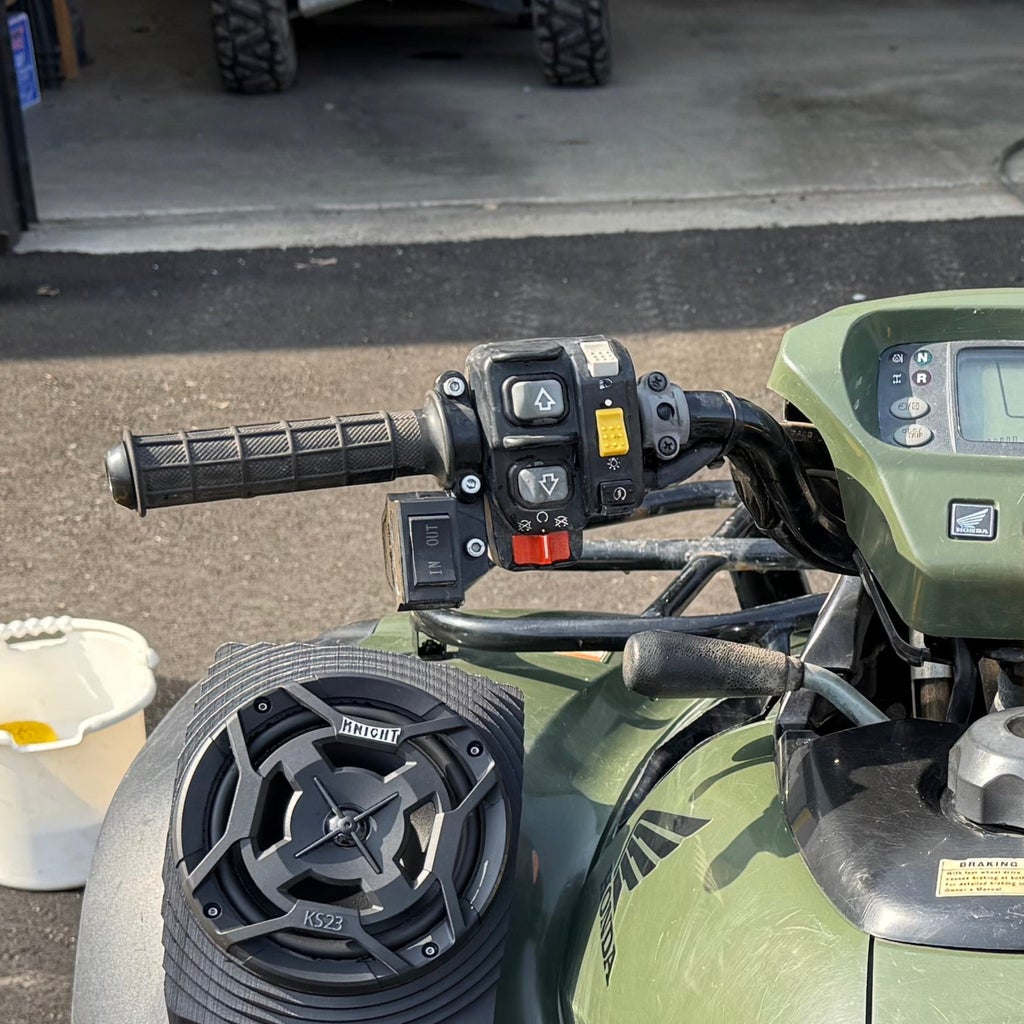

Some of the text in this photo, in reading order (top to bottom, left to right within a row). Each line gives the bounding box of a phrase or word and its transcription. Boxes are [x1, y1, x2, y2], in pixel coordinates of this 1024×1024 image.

[916, 352, 929, 363] N
[916, 373, 928, 384] R
[425, 523, 443, 575] IN OUT
[342, 718, 400, 743] KNIGHT
[303, 909, 344, 931] KS23
